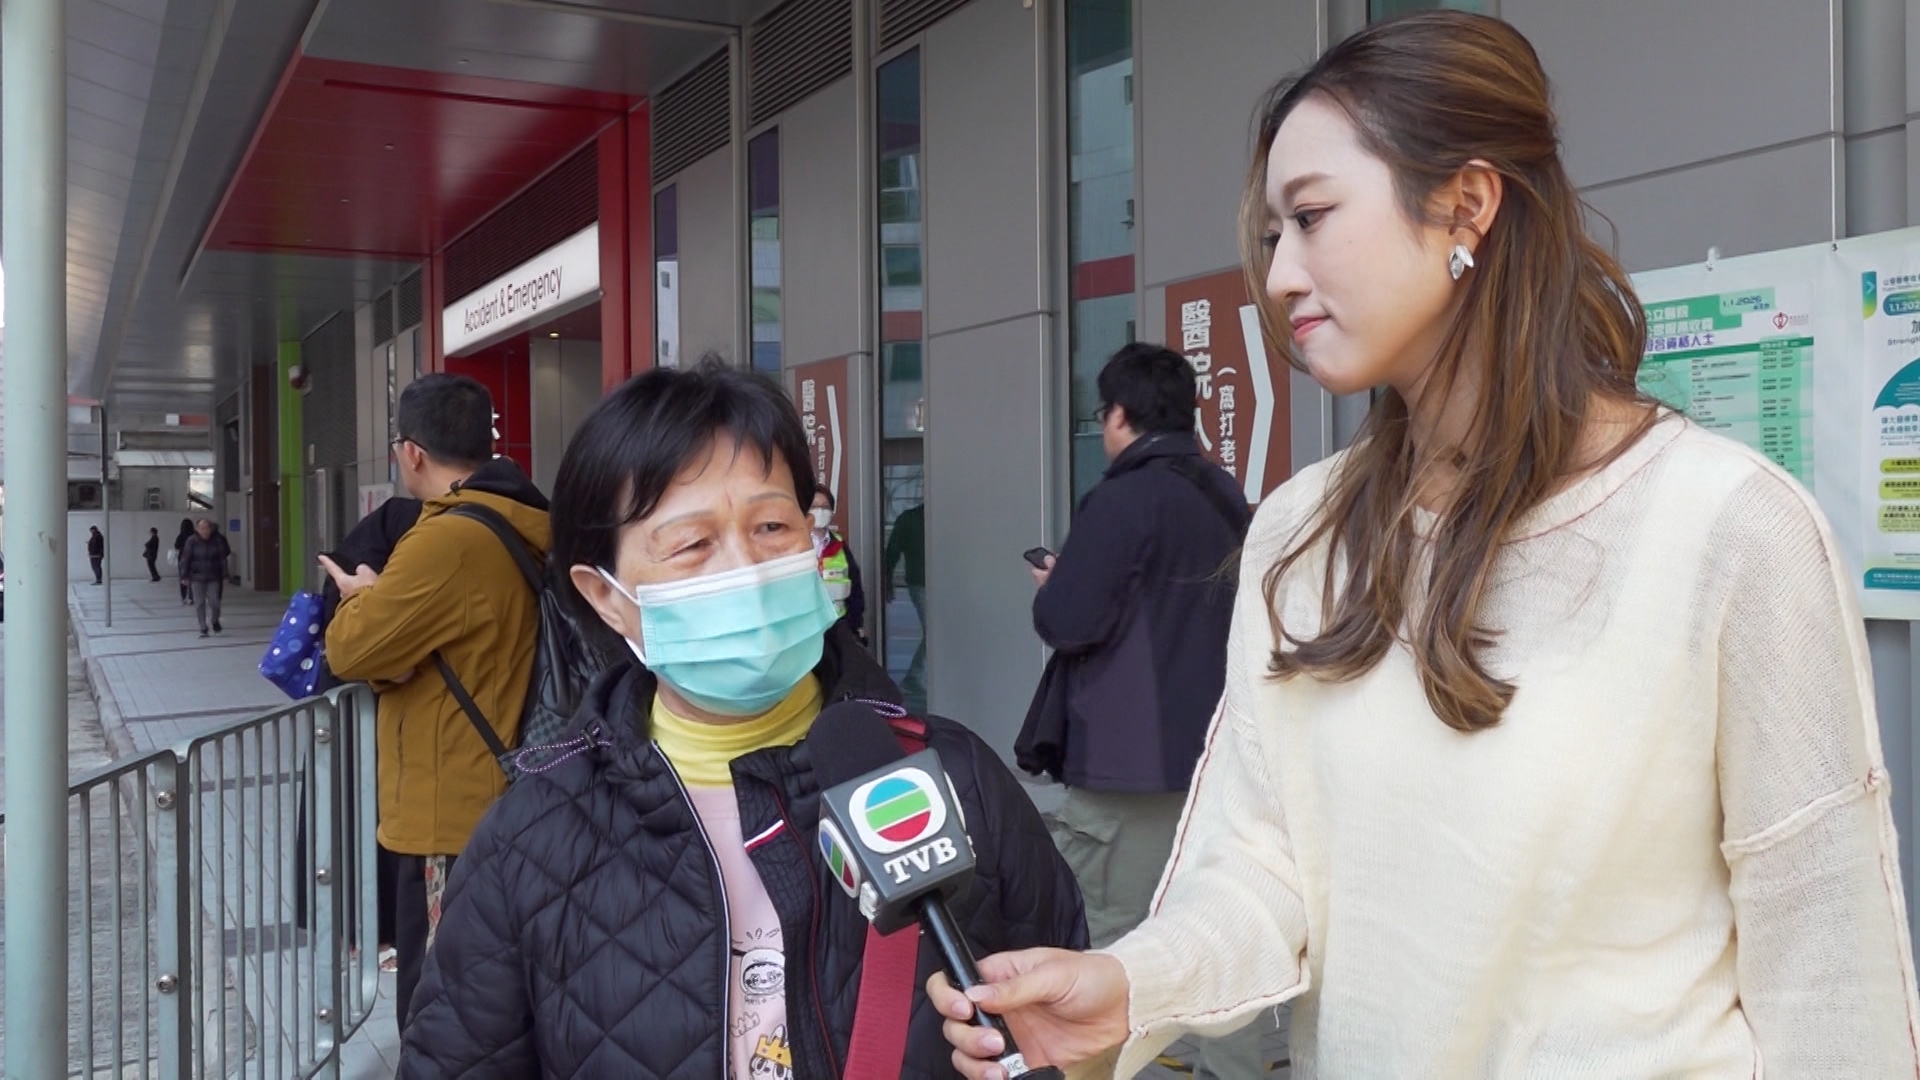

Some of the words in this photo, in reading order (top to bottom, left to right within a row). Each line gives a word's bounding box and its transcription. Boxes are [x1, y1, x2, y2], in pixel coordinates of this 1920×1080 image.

[464, 294, 499, 335] Accident
[500, 287, 506, 317] &
[507, 265, 562, 313] Emergency
[883, 836, 958, 885] TVB
